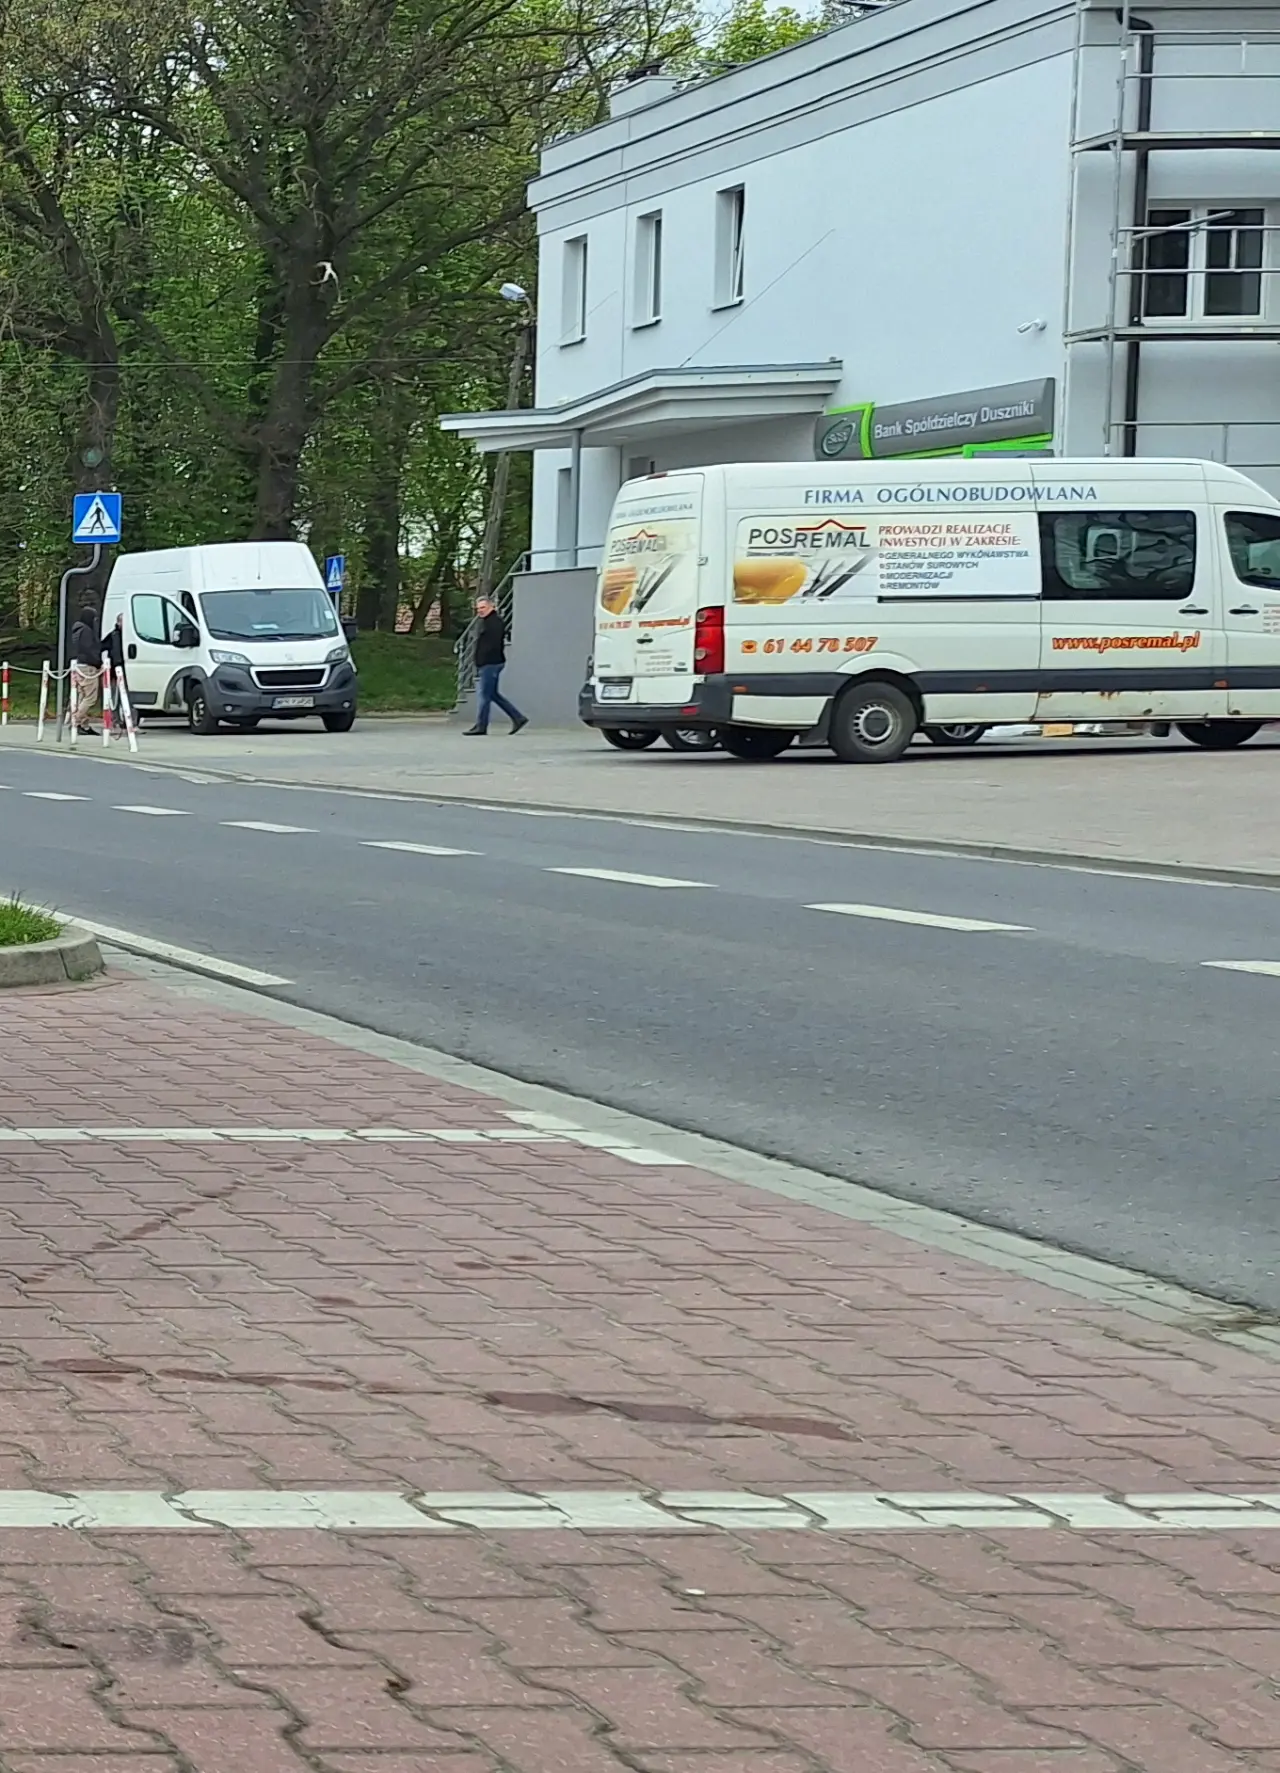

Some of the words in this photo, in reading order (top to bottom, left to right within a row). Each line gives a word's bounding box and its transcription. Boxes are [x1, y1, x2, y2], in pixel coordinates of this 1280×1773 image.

[874, 423, 902, 439] Bank
[904, 411, 977, 435] Spółdzielczy
[981, 400, 1035, 422] Duszniki
[804, 489, 864, 504] FIRMA
[877, 483, 1098, 503] OGÓLNOBUDOWLANA
[878, 525, 942, 535] PROWADZI
[946, 524, 1011, 535] REALIZACJE
[748, 528, 871, 548] POSREMAL
[879, 537, 947, 547] INWESTYCJI
[950, 537, 962, 546] W
[885, 551, 954, 560] GENERALNEGO
[885, 561, 925, 570] STANÓW
[927, 561, 979, 569] SUROWYCH
[885, 571, 954, 579] MODERNIZACJI
[885, 581, 940, 590] REMONTÓW
[763, 638, 785, 653] 61
[790, 638, 813, 653] 44
[816, 637, 840, 652] 78
[843, 636, 878, 652] 507
[1052, 630, 1200, 654] www.posremal.pl
